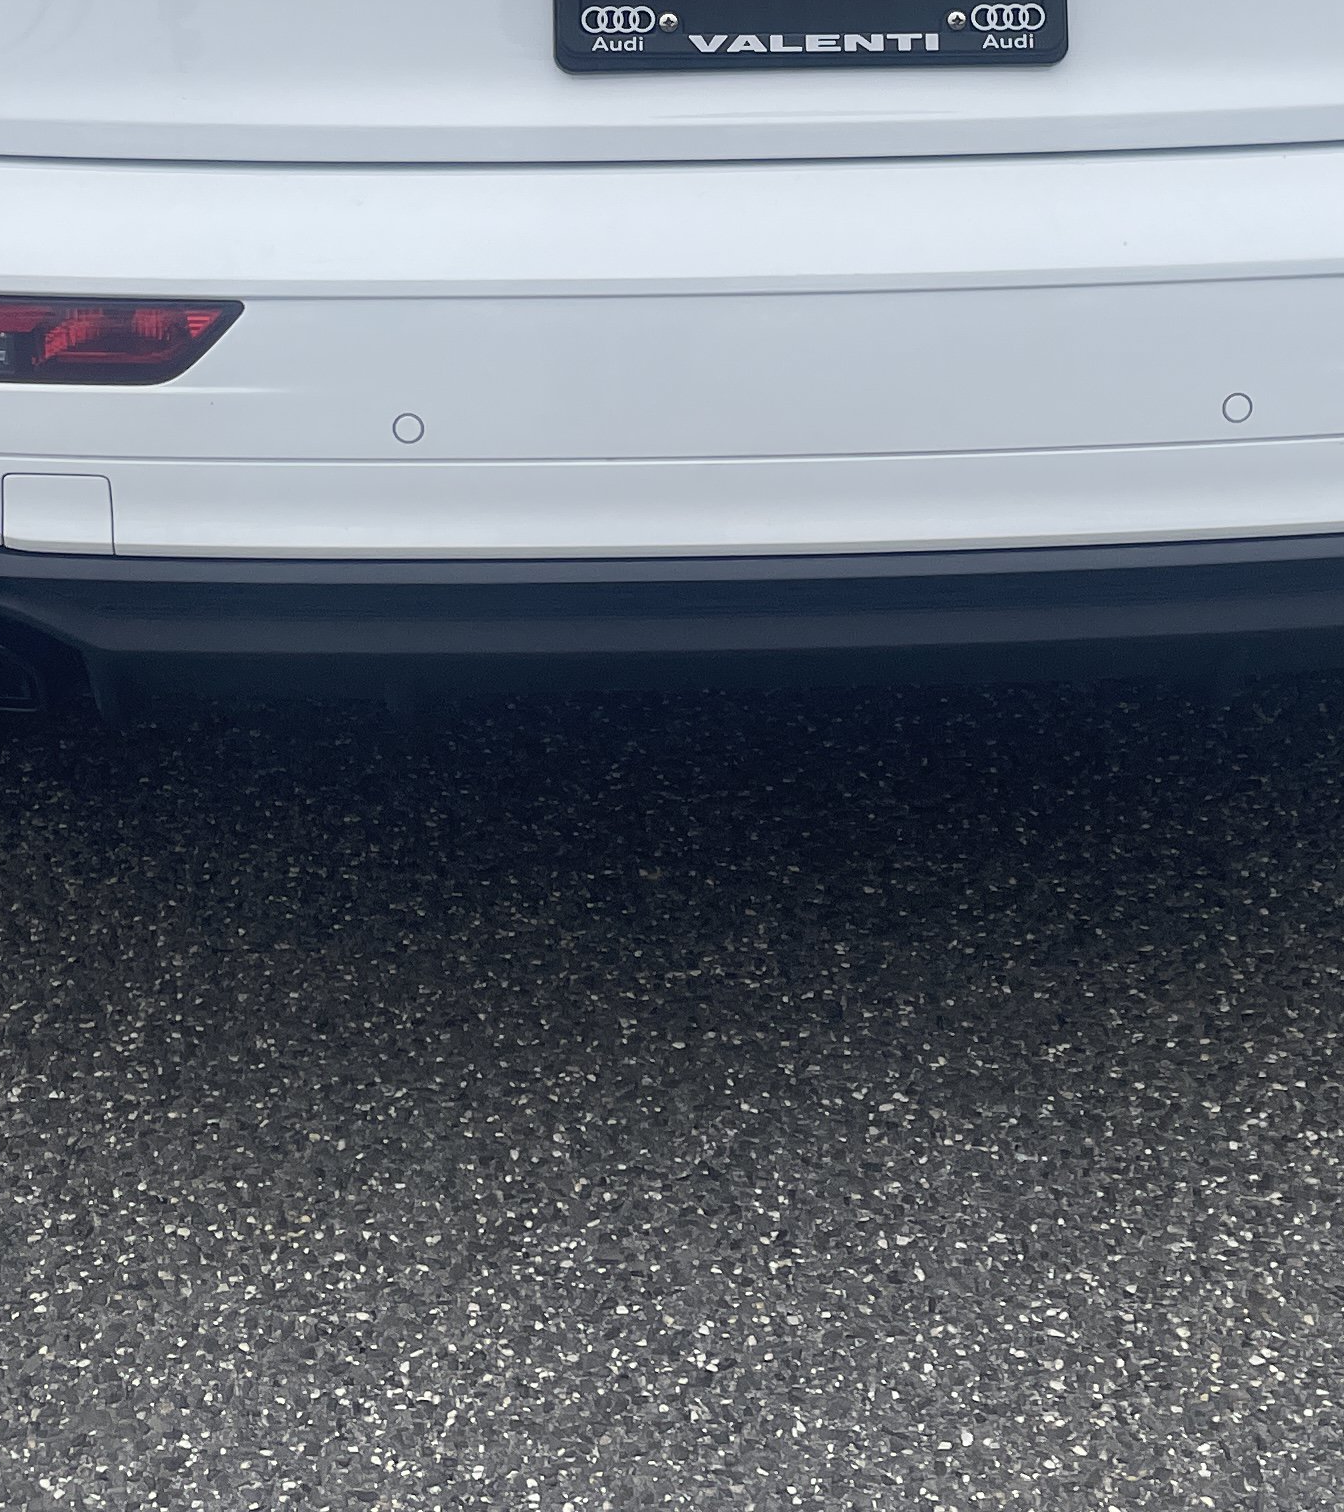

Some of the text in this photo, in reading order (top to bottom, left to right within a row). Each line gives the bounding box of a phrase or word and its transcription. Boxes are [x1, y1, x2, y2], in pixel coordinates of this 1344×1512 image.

[592, 36, 644, 52] Audi
[688, 33, 939, 53] VALENTI
[982, 33, 1034, 49] Audi
